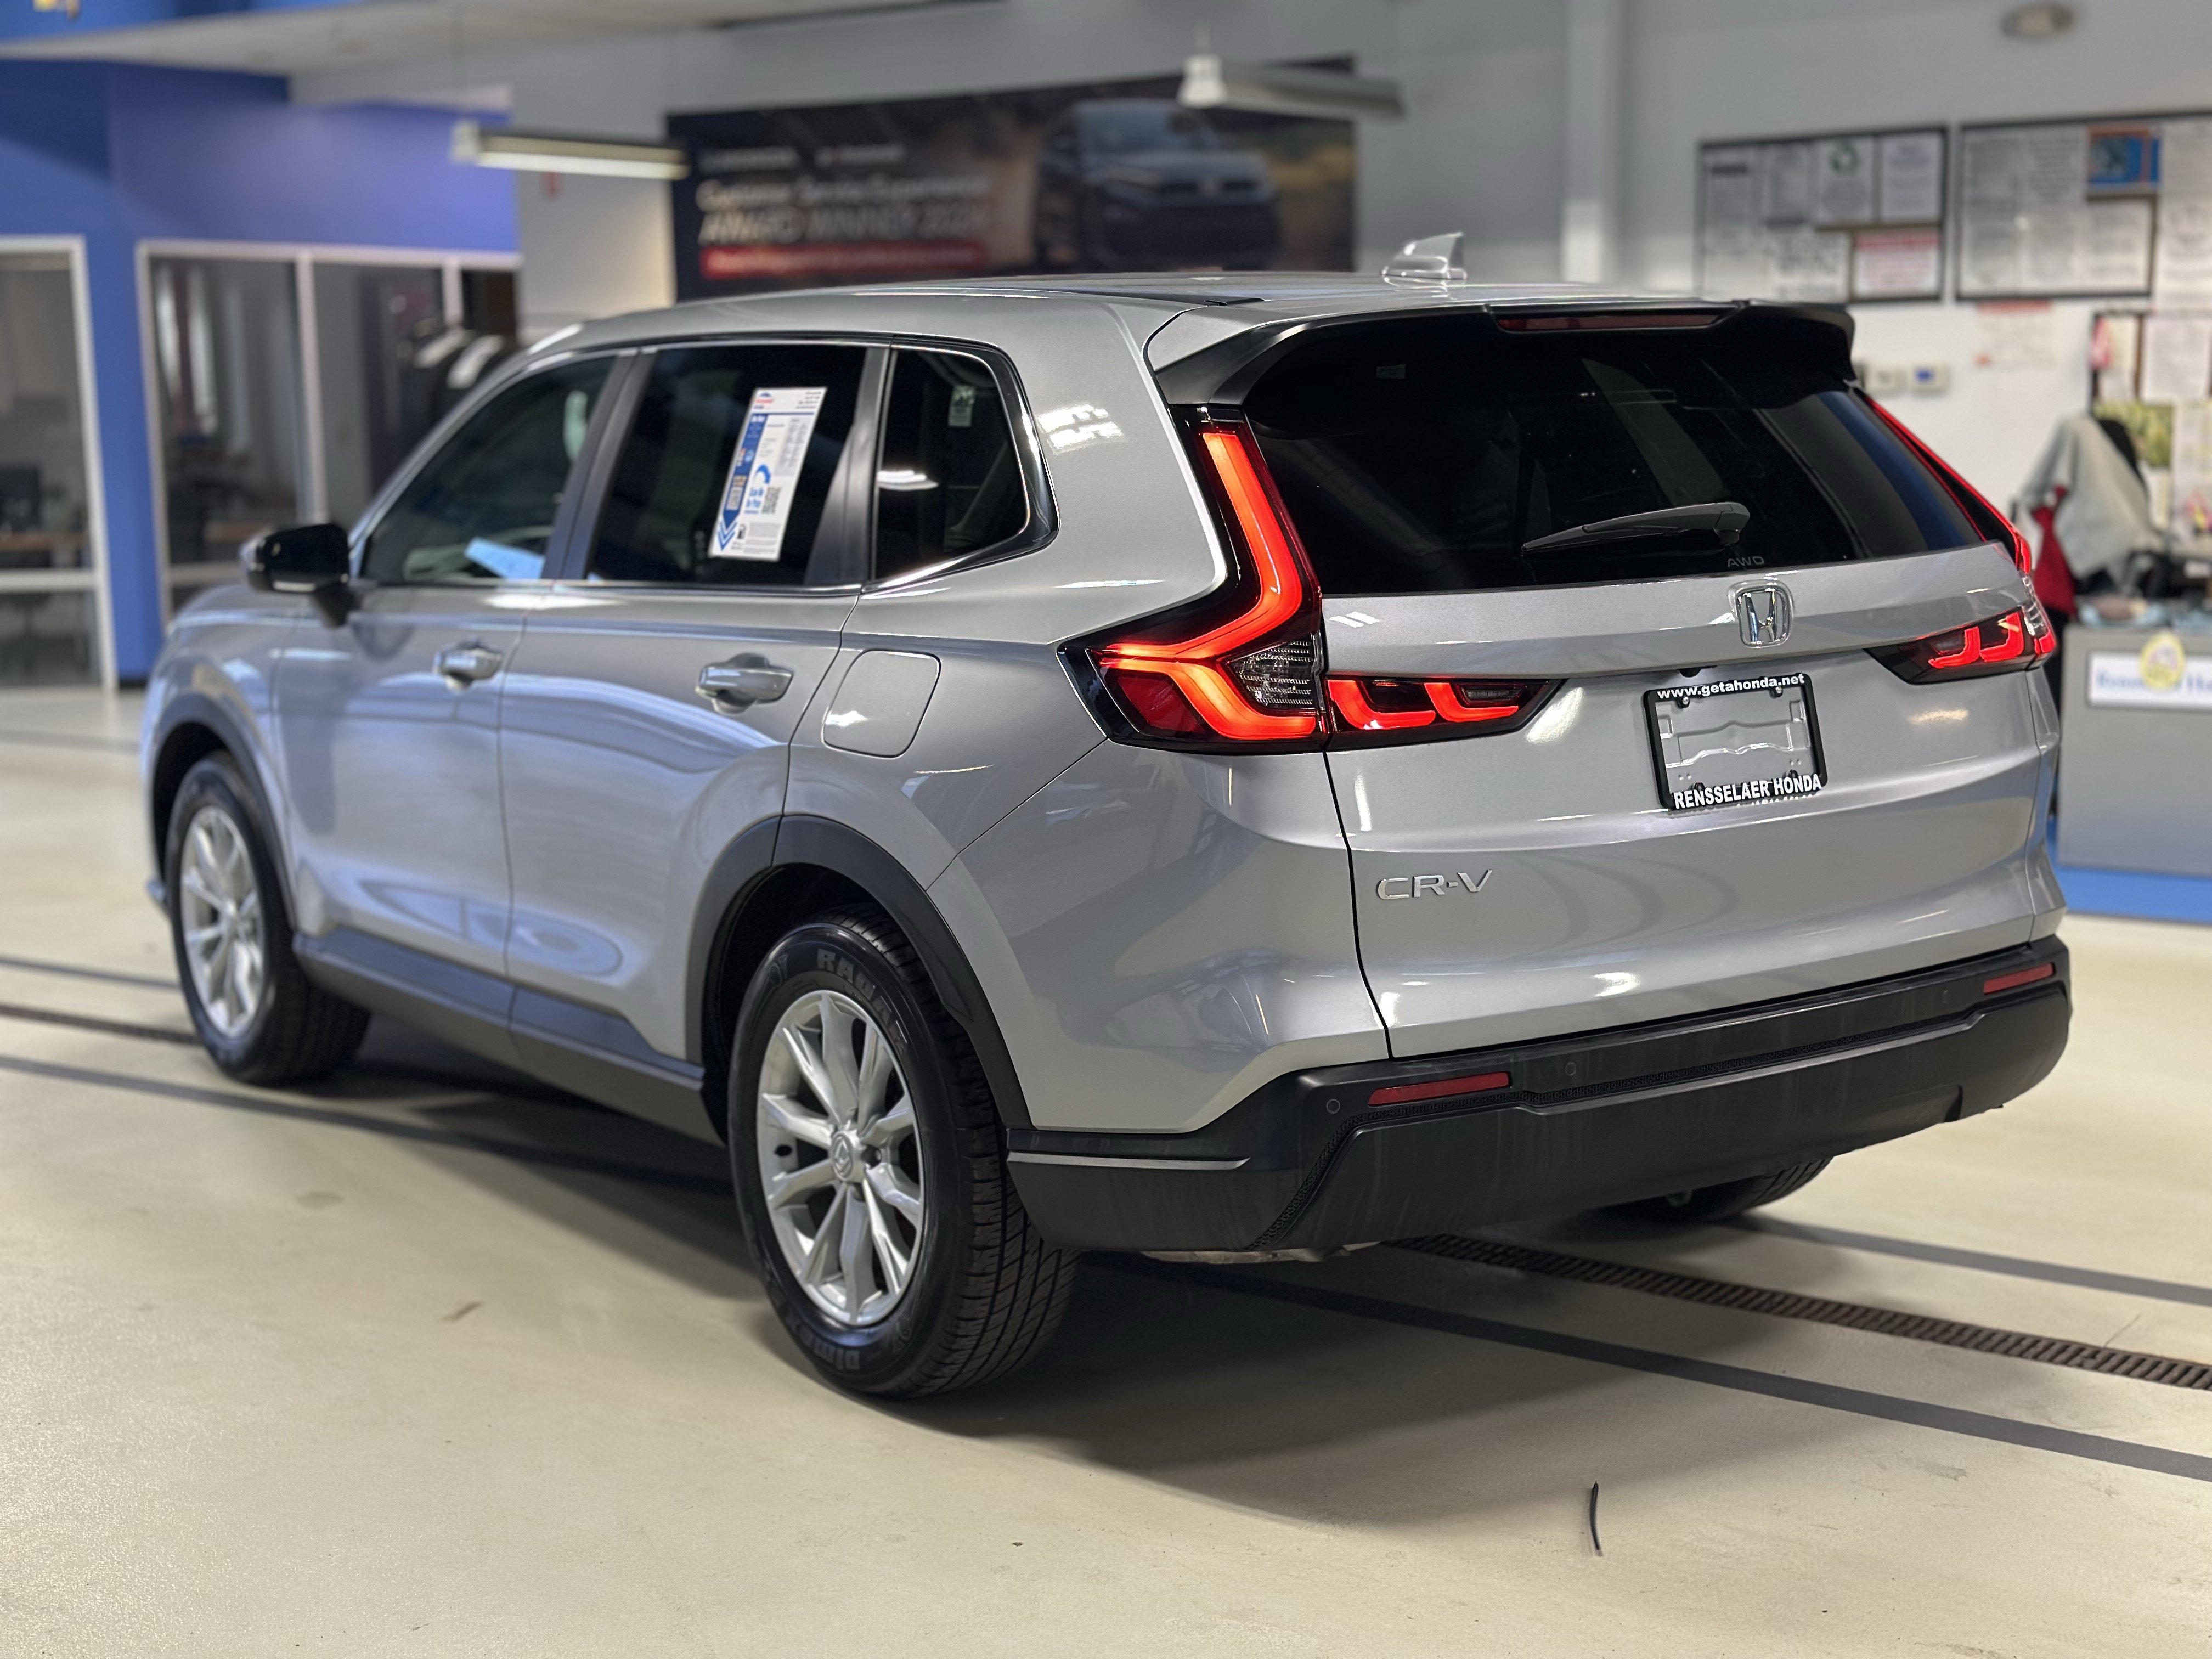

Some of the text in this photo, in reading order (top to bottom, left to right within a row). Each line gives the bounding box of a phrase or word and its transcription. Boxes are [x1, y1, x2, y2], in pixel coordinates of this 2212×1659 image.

[1727, 556, 1764, 568] AWD
[1657, 673, 1804, 699] www.getahonda.net
[1674, 773, 1822, 810] RENSSELAER HONDA
[1375, 869, 1493, 900] CR-V
